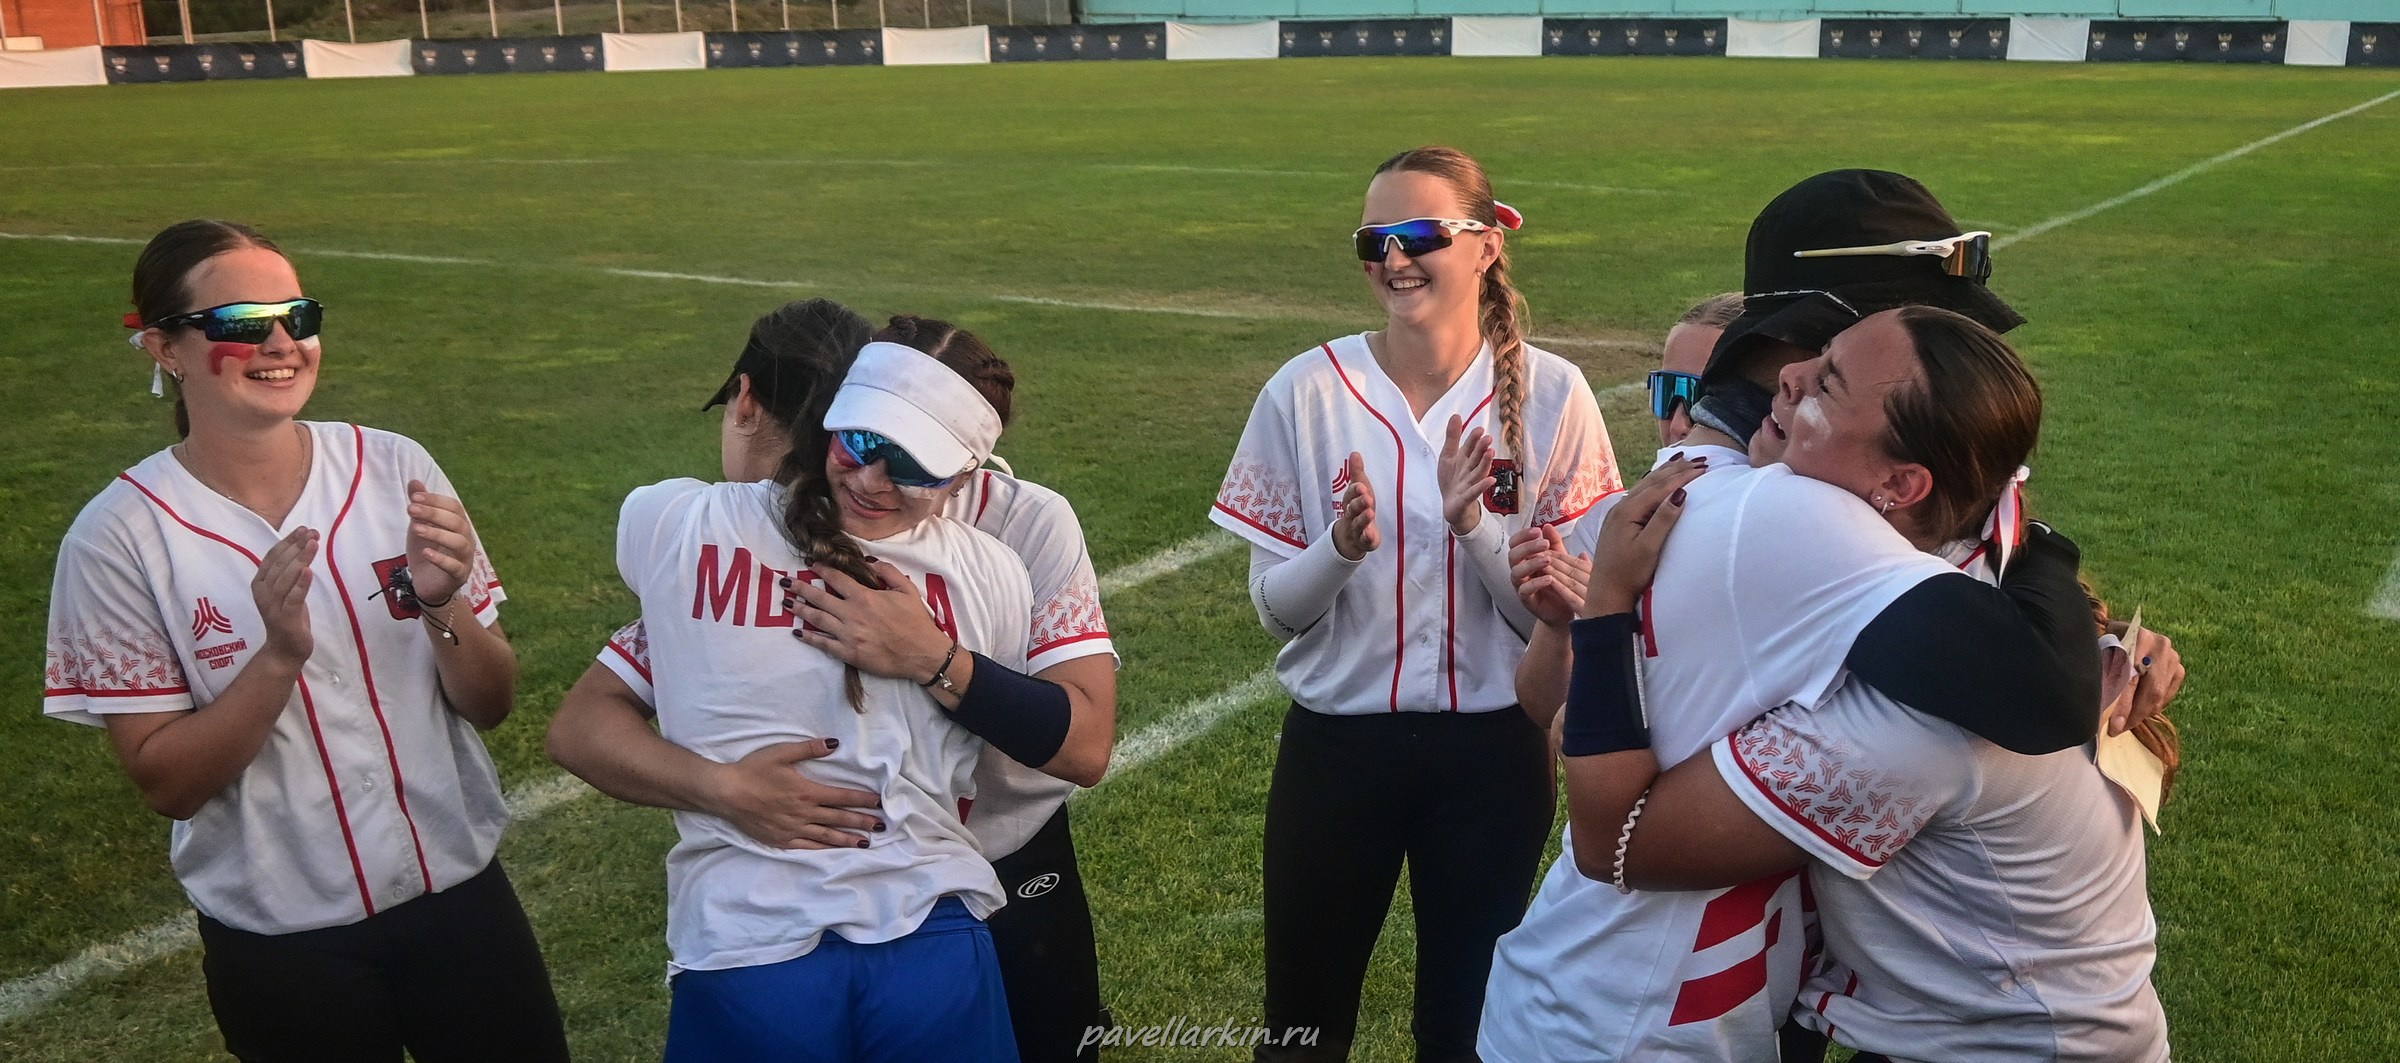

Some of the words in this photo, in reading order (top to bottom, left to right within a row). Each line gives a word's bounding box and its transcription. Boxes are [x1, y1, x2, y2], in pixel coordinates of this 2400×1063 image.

[692, 544, 958, 642] МОА
[194, 638, 248, 660] МОСКОВСКИЙ
[209, 655, 235, 670] СПОРТ
